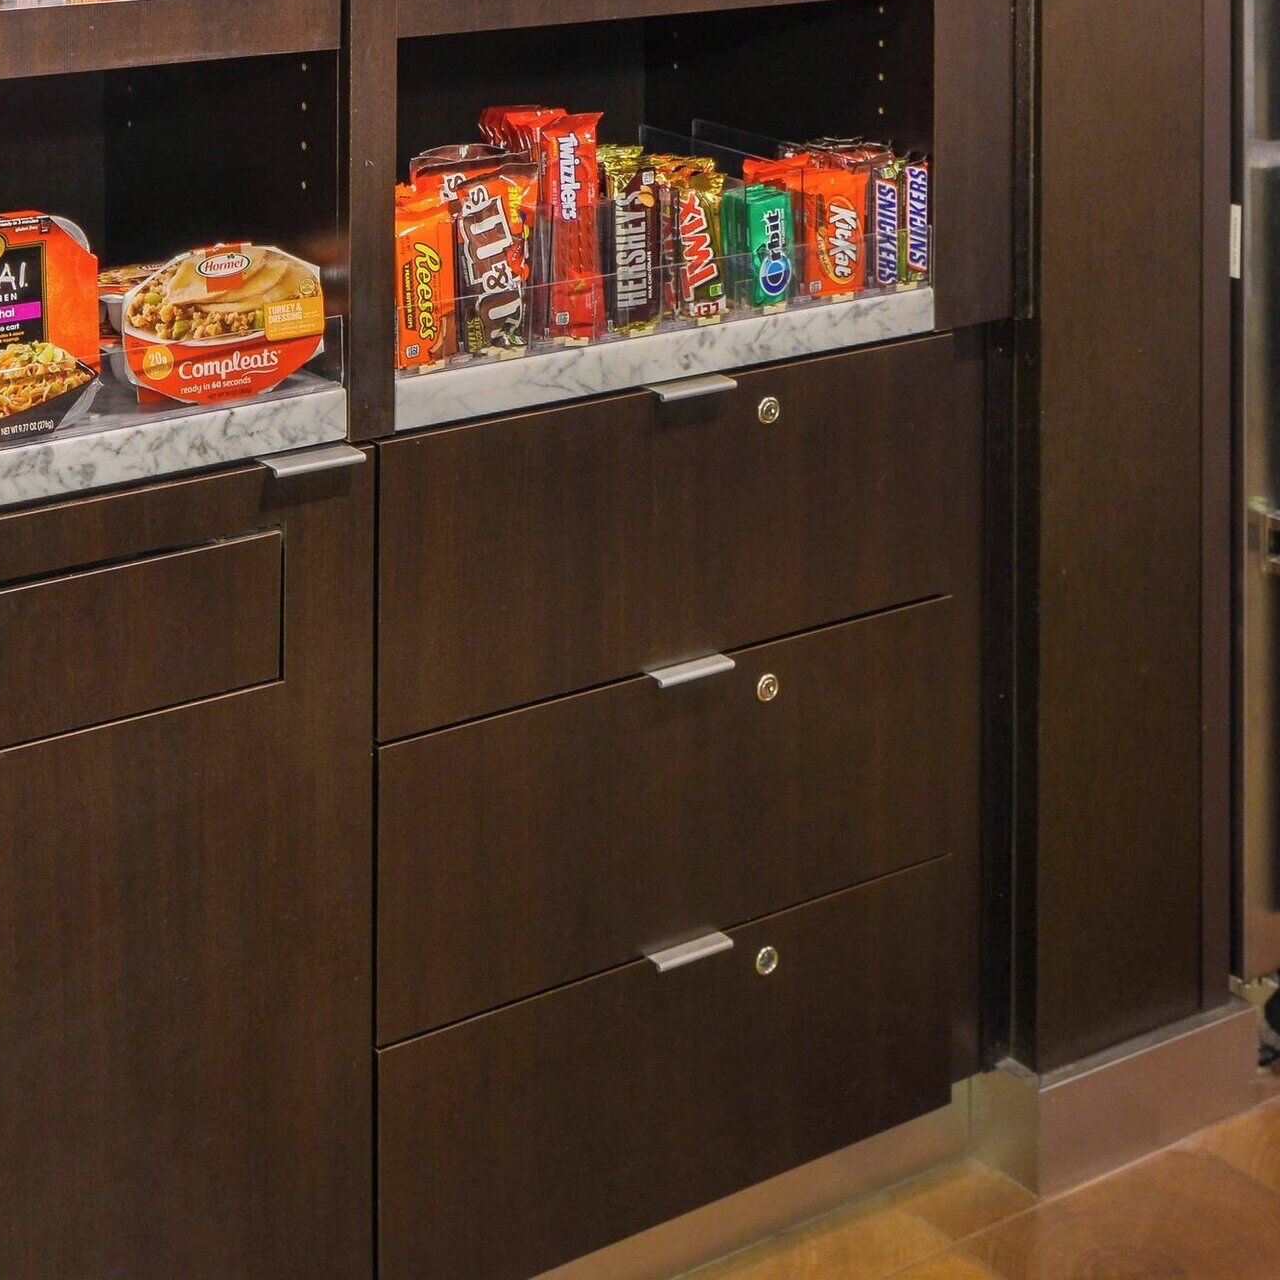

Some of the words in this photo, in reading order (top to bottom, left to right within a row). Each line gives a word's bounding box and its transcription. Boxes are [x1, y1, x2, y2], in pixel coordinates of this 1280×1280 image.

[558, 132, 582, 220] Twizzlers
[876, 183, 898, 286] SNICKERS
[906, 167, 928, 271] SNICKERS
[204, 257, 245, 273] Hormel
[615, 190, 648, 308] HERSHEY'S
[413, 242, 442, 340] Reese's
[268, 304, 296, 316] TURKEY
[268, 311, 303, 324] DRESSING
[5, 322, 21, 332] cart
[178, 348, 279, 381] Compleats
[180, 384, 202, 395] ready
[203, 383, 211, 392] in
[211, 380, 222, 389] 60
[222, 376, 252, 388] seconds
